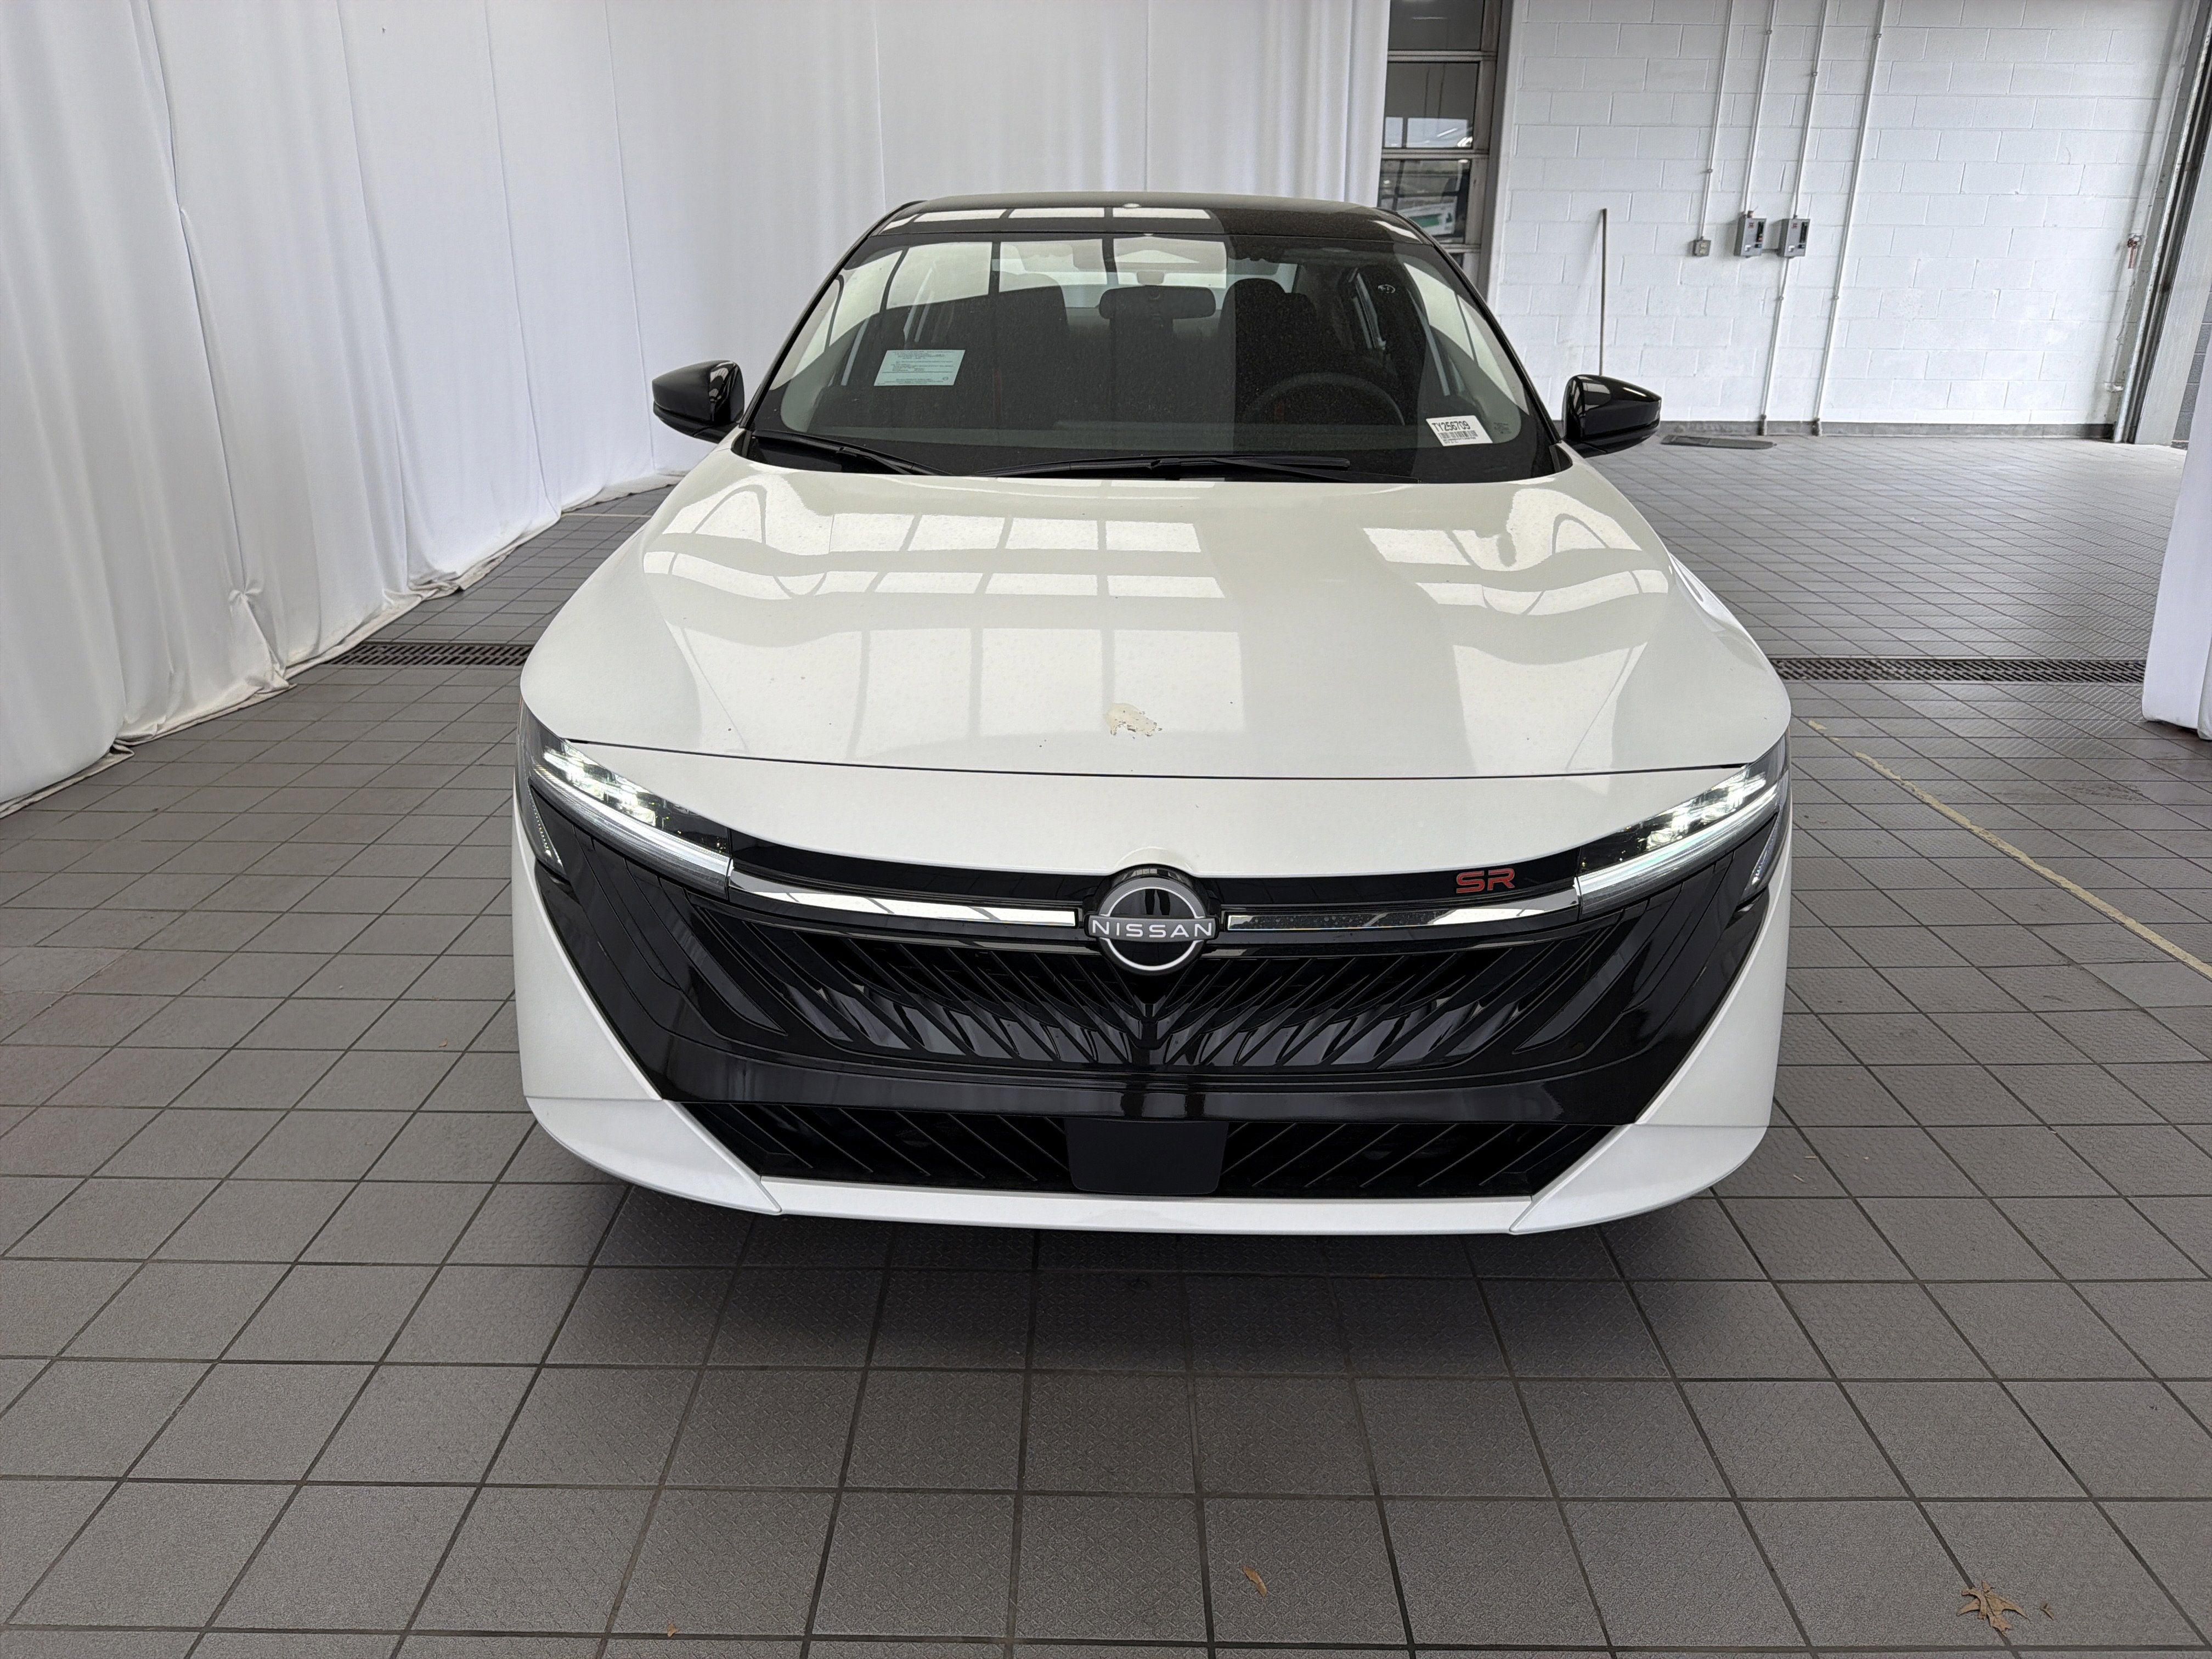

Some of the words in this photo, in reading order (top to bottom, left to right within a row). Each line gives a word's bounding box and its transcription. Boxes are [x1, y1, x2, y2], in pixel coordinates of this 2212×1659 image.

[1431, 420, 1470, 432] TY256709
[1456, 867, 1515, 894] SR
[1092, 919, 1212, 938] NISSAN
